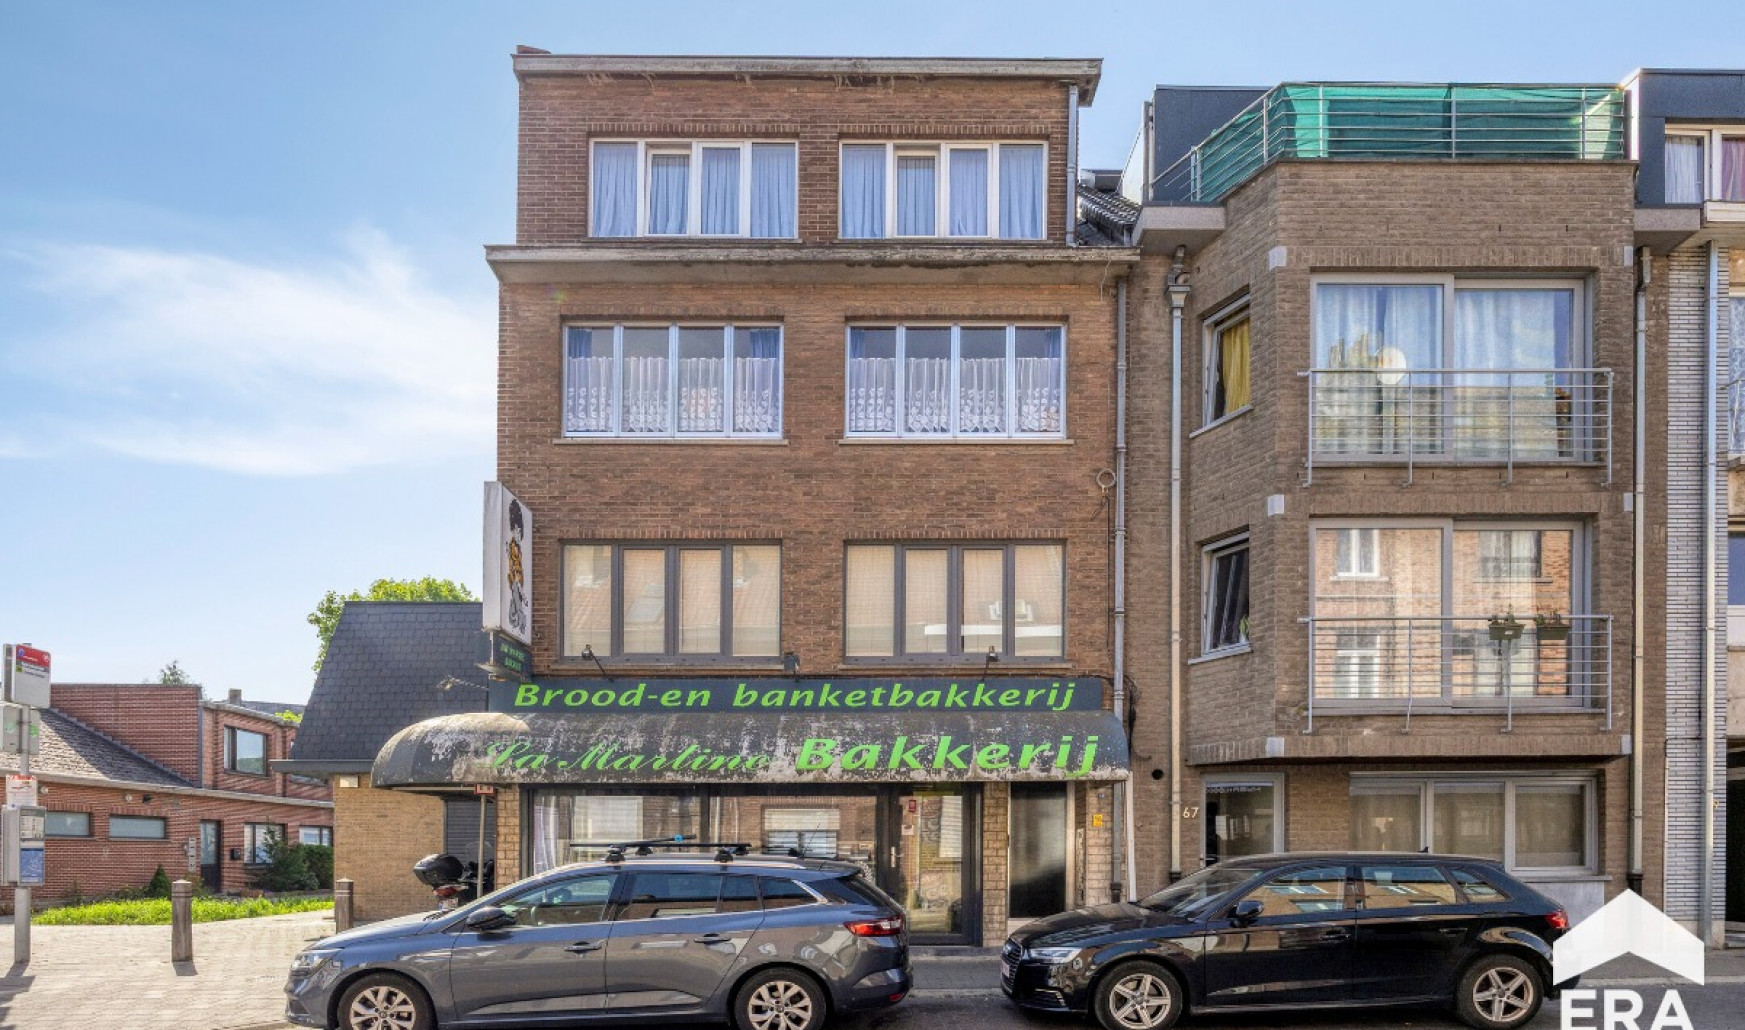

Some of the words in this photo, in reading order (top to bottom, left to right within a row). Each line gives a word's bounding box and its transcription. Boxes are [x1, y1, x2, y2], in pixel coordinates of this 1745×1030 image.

[514, 683, 711, 707] Brood-en
[732, 683, 1075, 711] banketbakkerij
[484, 740, 549, 769] La
[795, 735, 1099, 778] Bakkerij
[1182, 806, 1199, 819] 67
